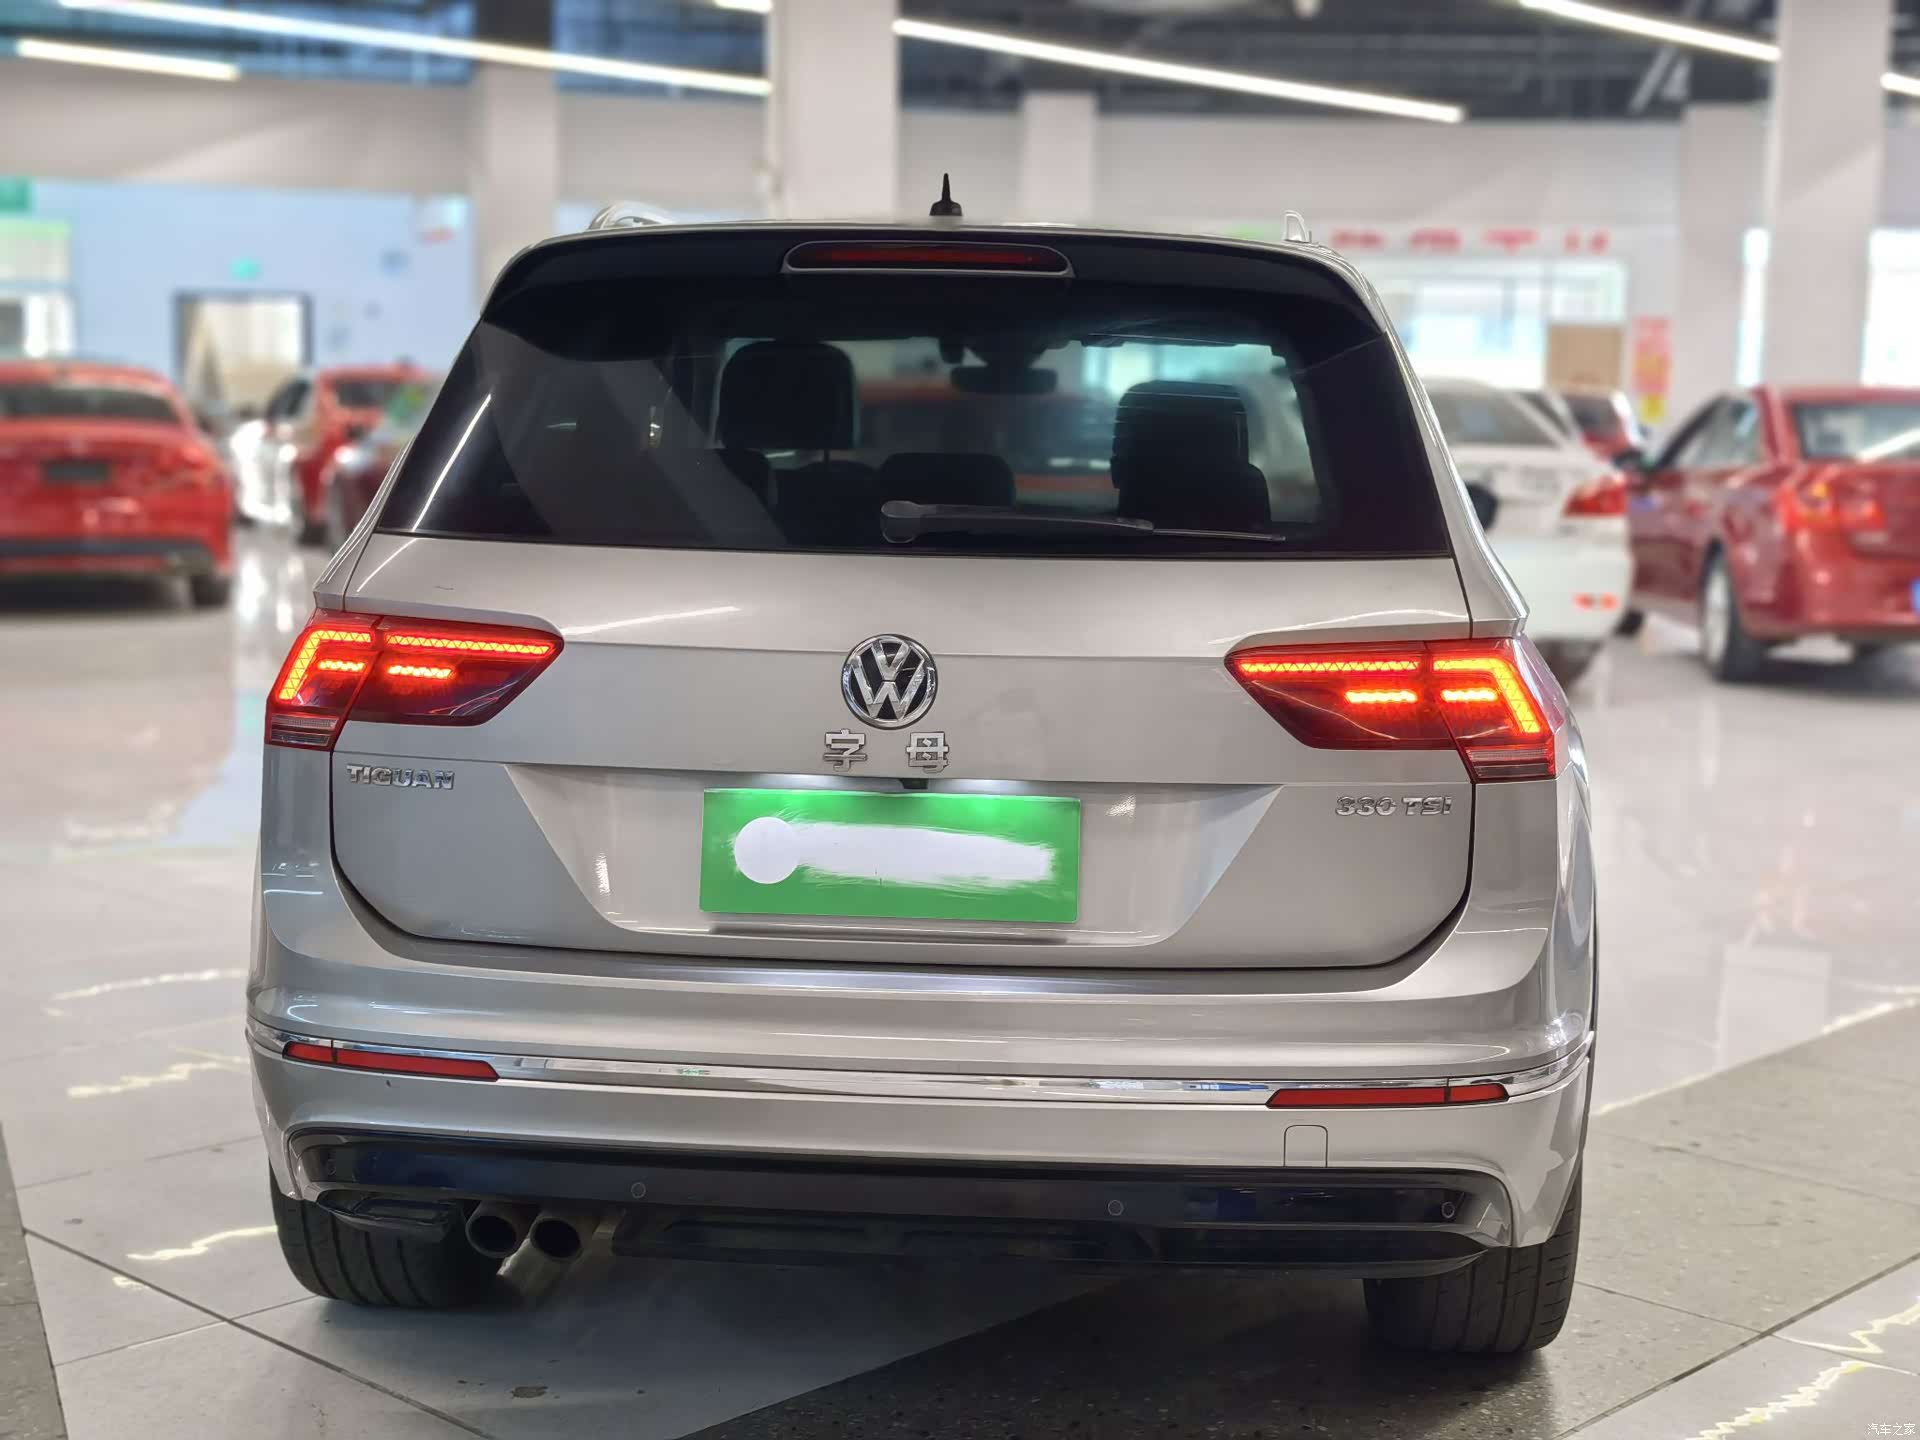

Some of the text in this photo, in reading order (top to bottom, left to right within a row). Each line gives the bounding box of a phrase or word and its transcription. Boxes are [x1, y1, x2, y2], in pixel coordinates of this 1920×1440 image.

[845, 637, 931, 724] VW
[346, 764, 454, 790] TIGUAN
[1336, 796, 1396, 816] 330
